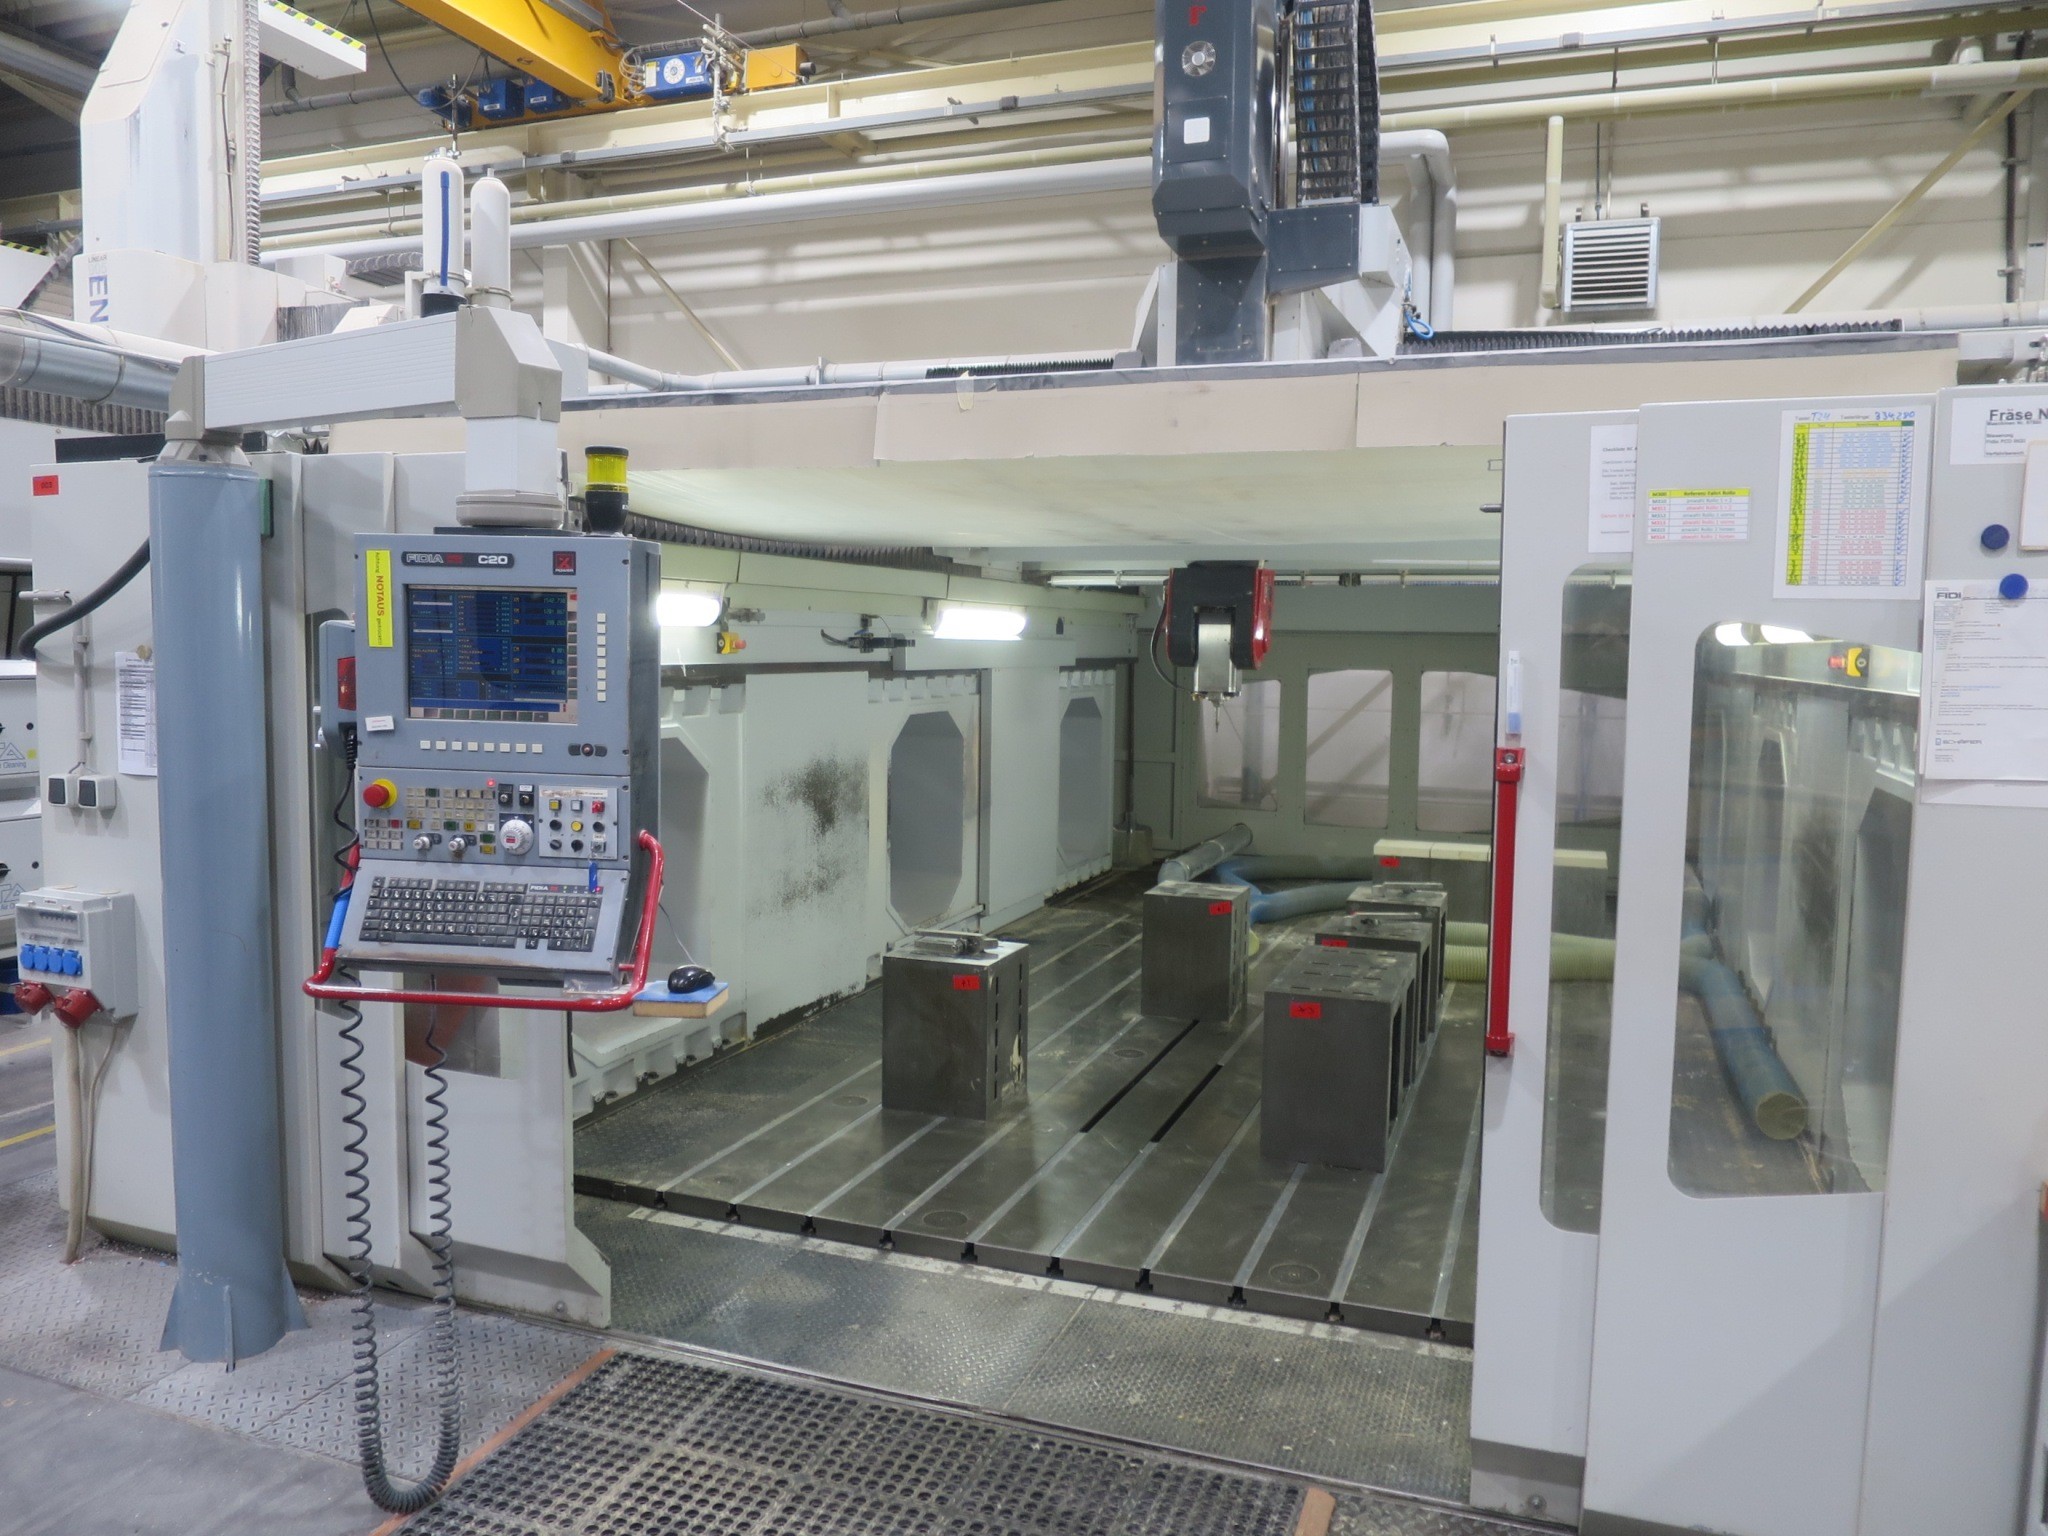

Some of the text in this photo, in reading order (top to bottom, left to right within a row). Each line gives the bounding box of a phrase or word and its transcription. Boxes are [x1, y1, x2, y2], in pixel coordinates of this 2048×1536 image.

[89, 274, 109, 327] EN
[1989, 408, 2033, 421] Fräse
[406, 553, 508, 565] FIDIA C20
[376, 575, 385, 617] NOTAUS
